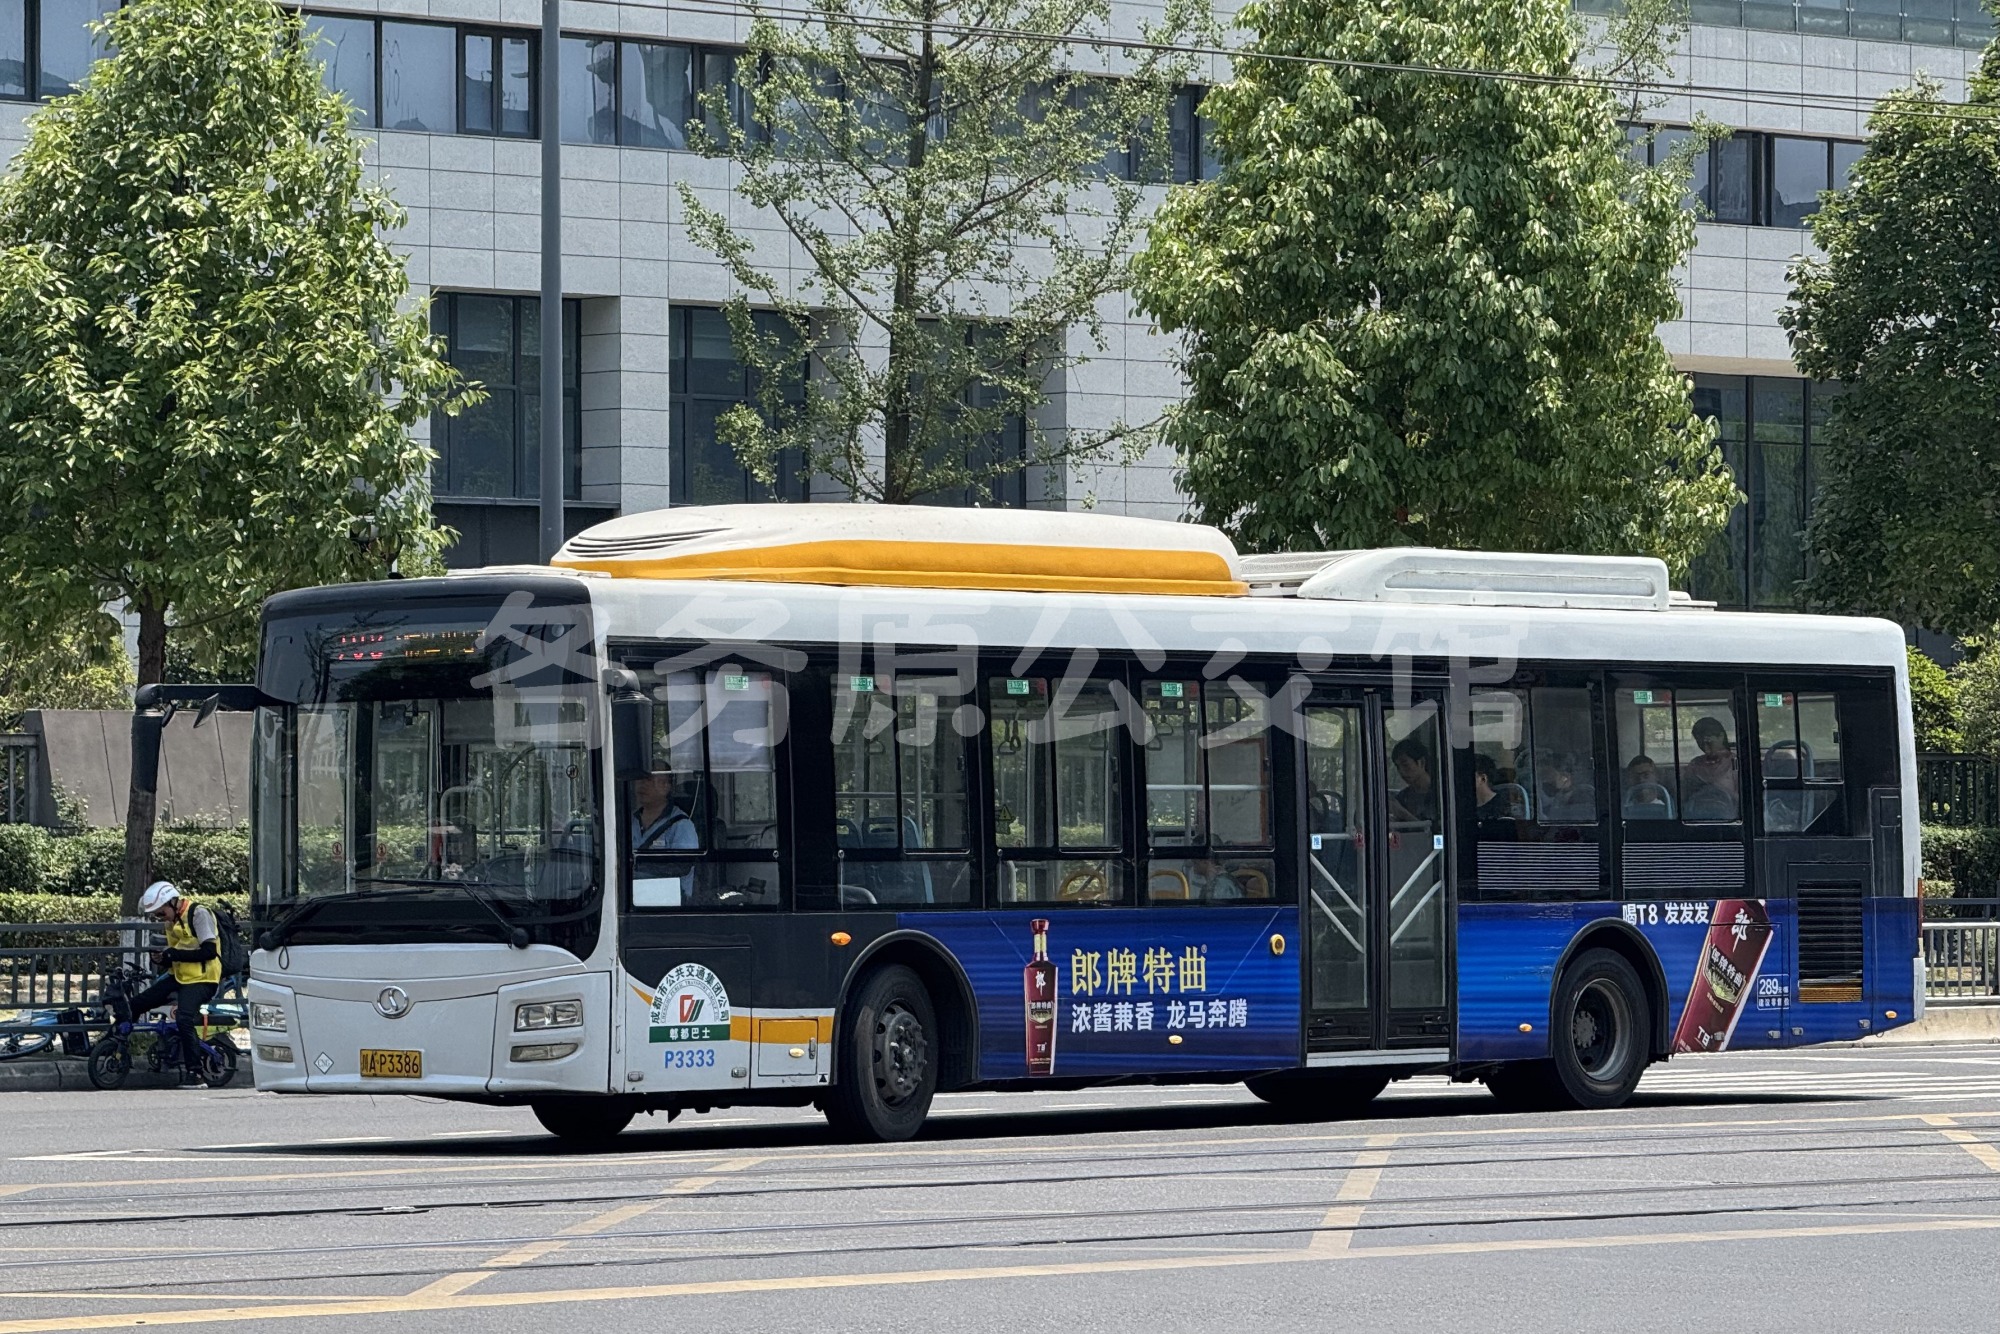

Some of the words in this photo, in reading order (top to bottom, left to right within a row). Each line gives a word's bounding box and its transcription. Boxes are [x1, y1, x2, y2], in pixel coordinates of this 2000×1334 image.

[1622, 903, 1658, 925] 喝T8
[1664, 902, 1709, 925] 发发发
[1071, 945, 1207, 996] 郎牌特曲
[1711, 947, 1743, 987] 郎牌特曲
[651, 964, 729, 1025] 成都市公共交通集团公司
[1071, 1001, 1154, 1033] 浓酱兼香
[1166, 998, 1248, 1030] 龙马奔腾
[664, 1049, 715, 1069] P3333
